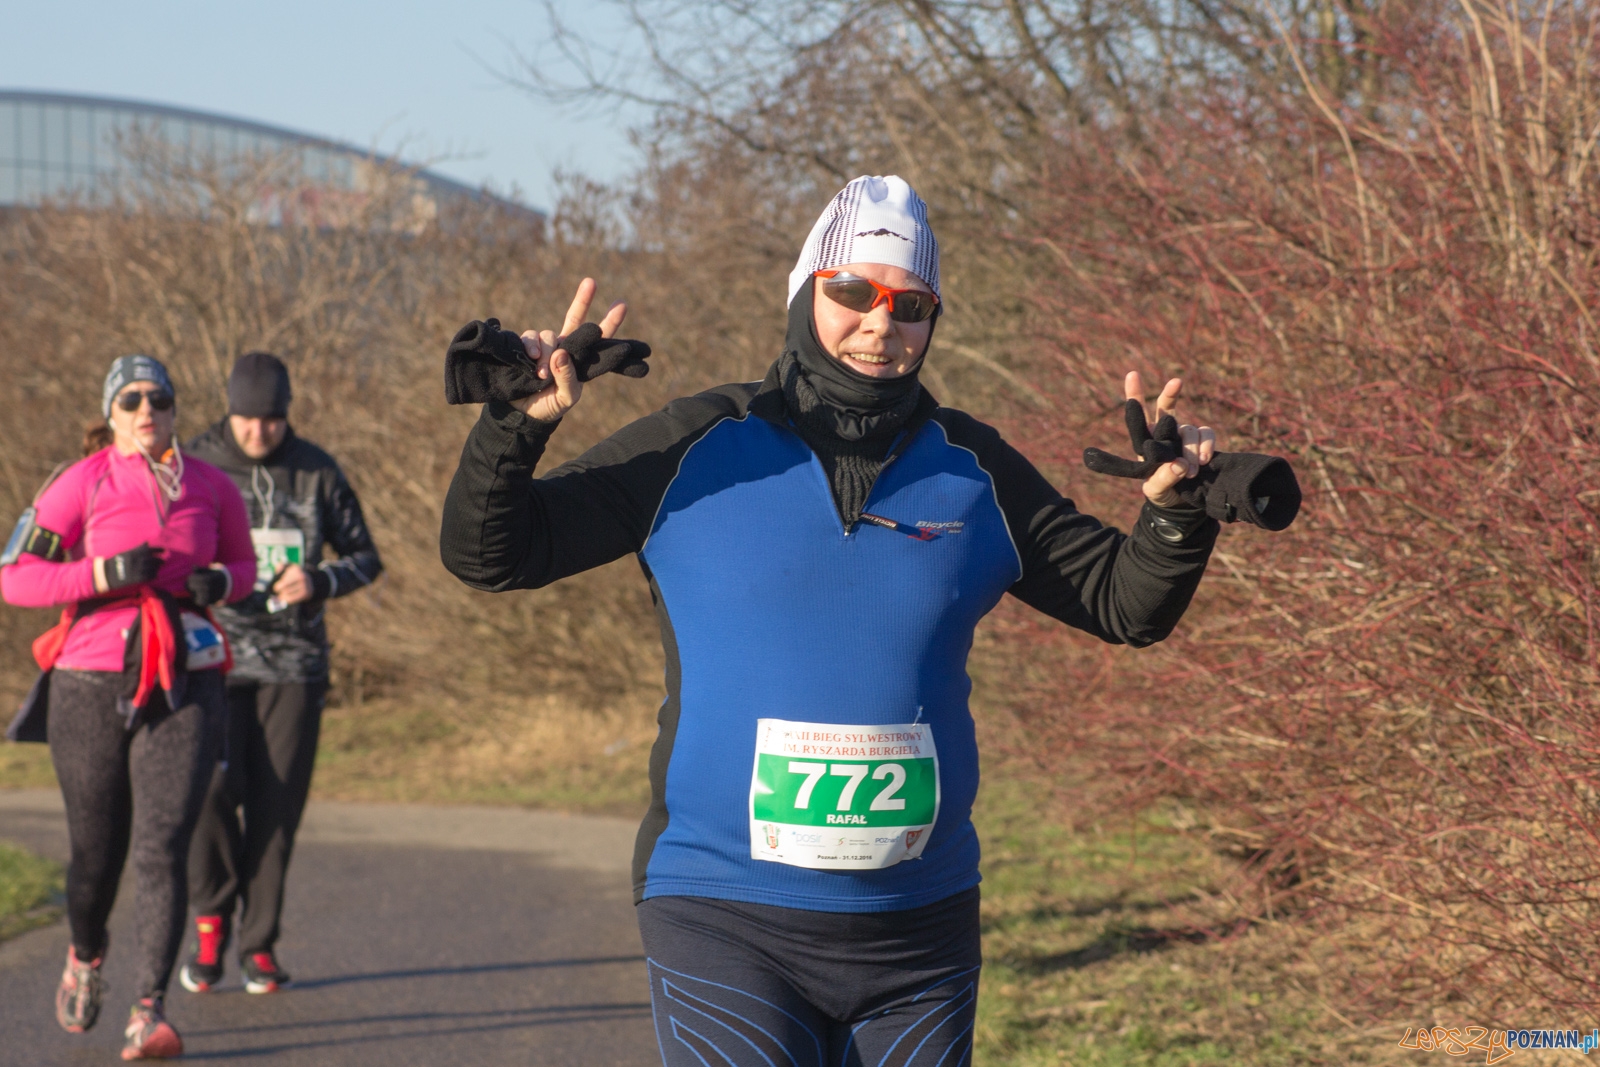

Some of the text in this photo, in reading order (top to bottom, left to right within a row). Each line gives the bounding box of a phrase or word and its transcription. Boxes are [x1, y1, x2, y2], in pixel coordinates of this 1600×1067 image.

[915, 520, 965, 529] Bicycle
[813, 732, 842, 743] BIEG
[844, 731, 922, 743] SYLWESTROWY
[802, 744, 866, 756] RYSZARDA
[869, 745, 921, 756] BURGIELA
[788, 761, 907, 811] 772
[826, 814, 868, 824] RAFAŁ
